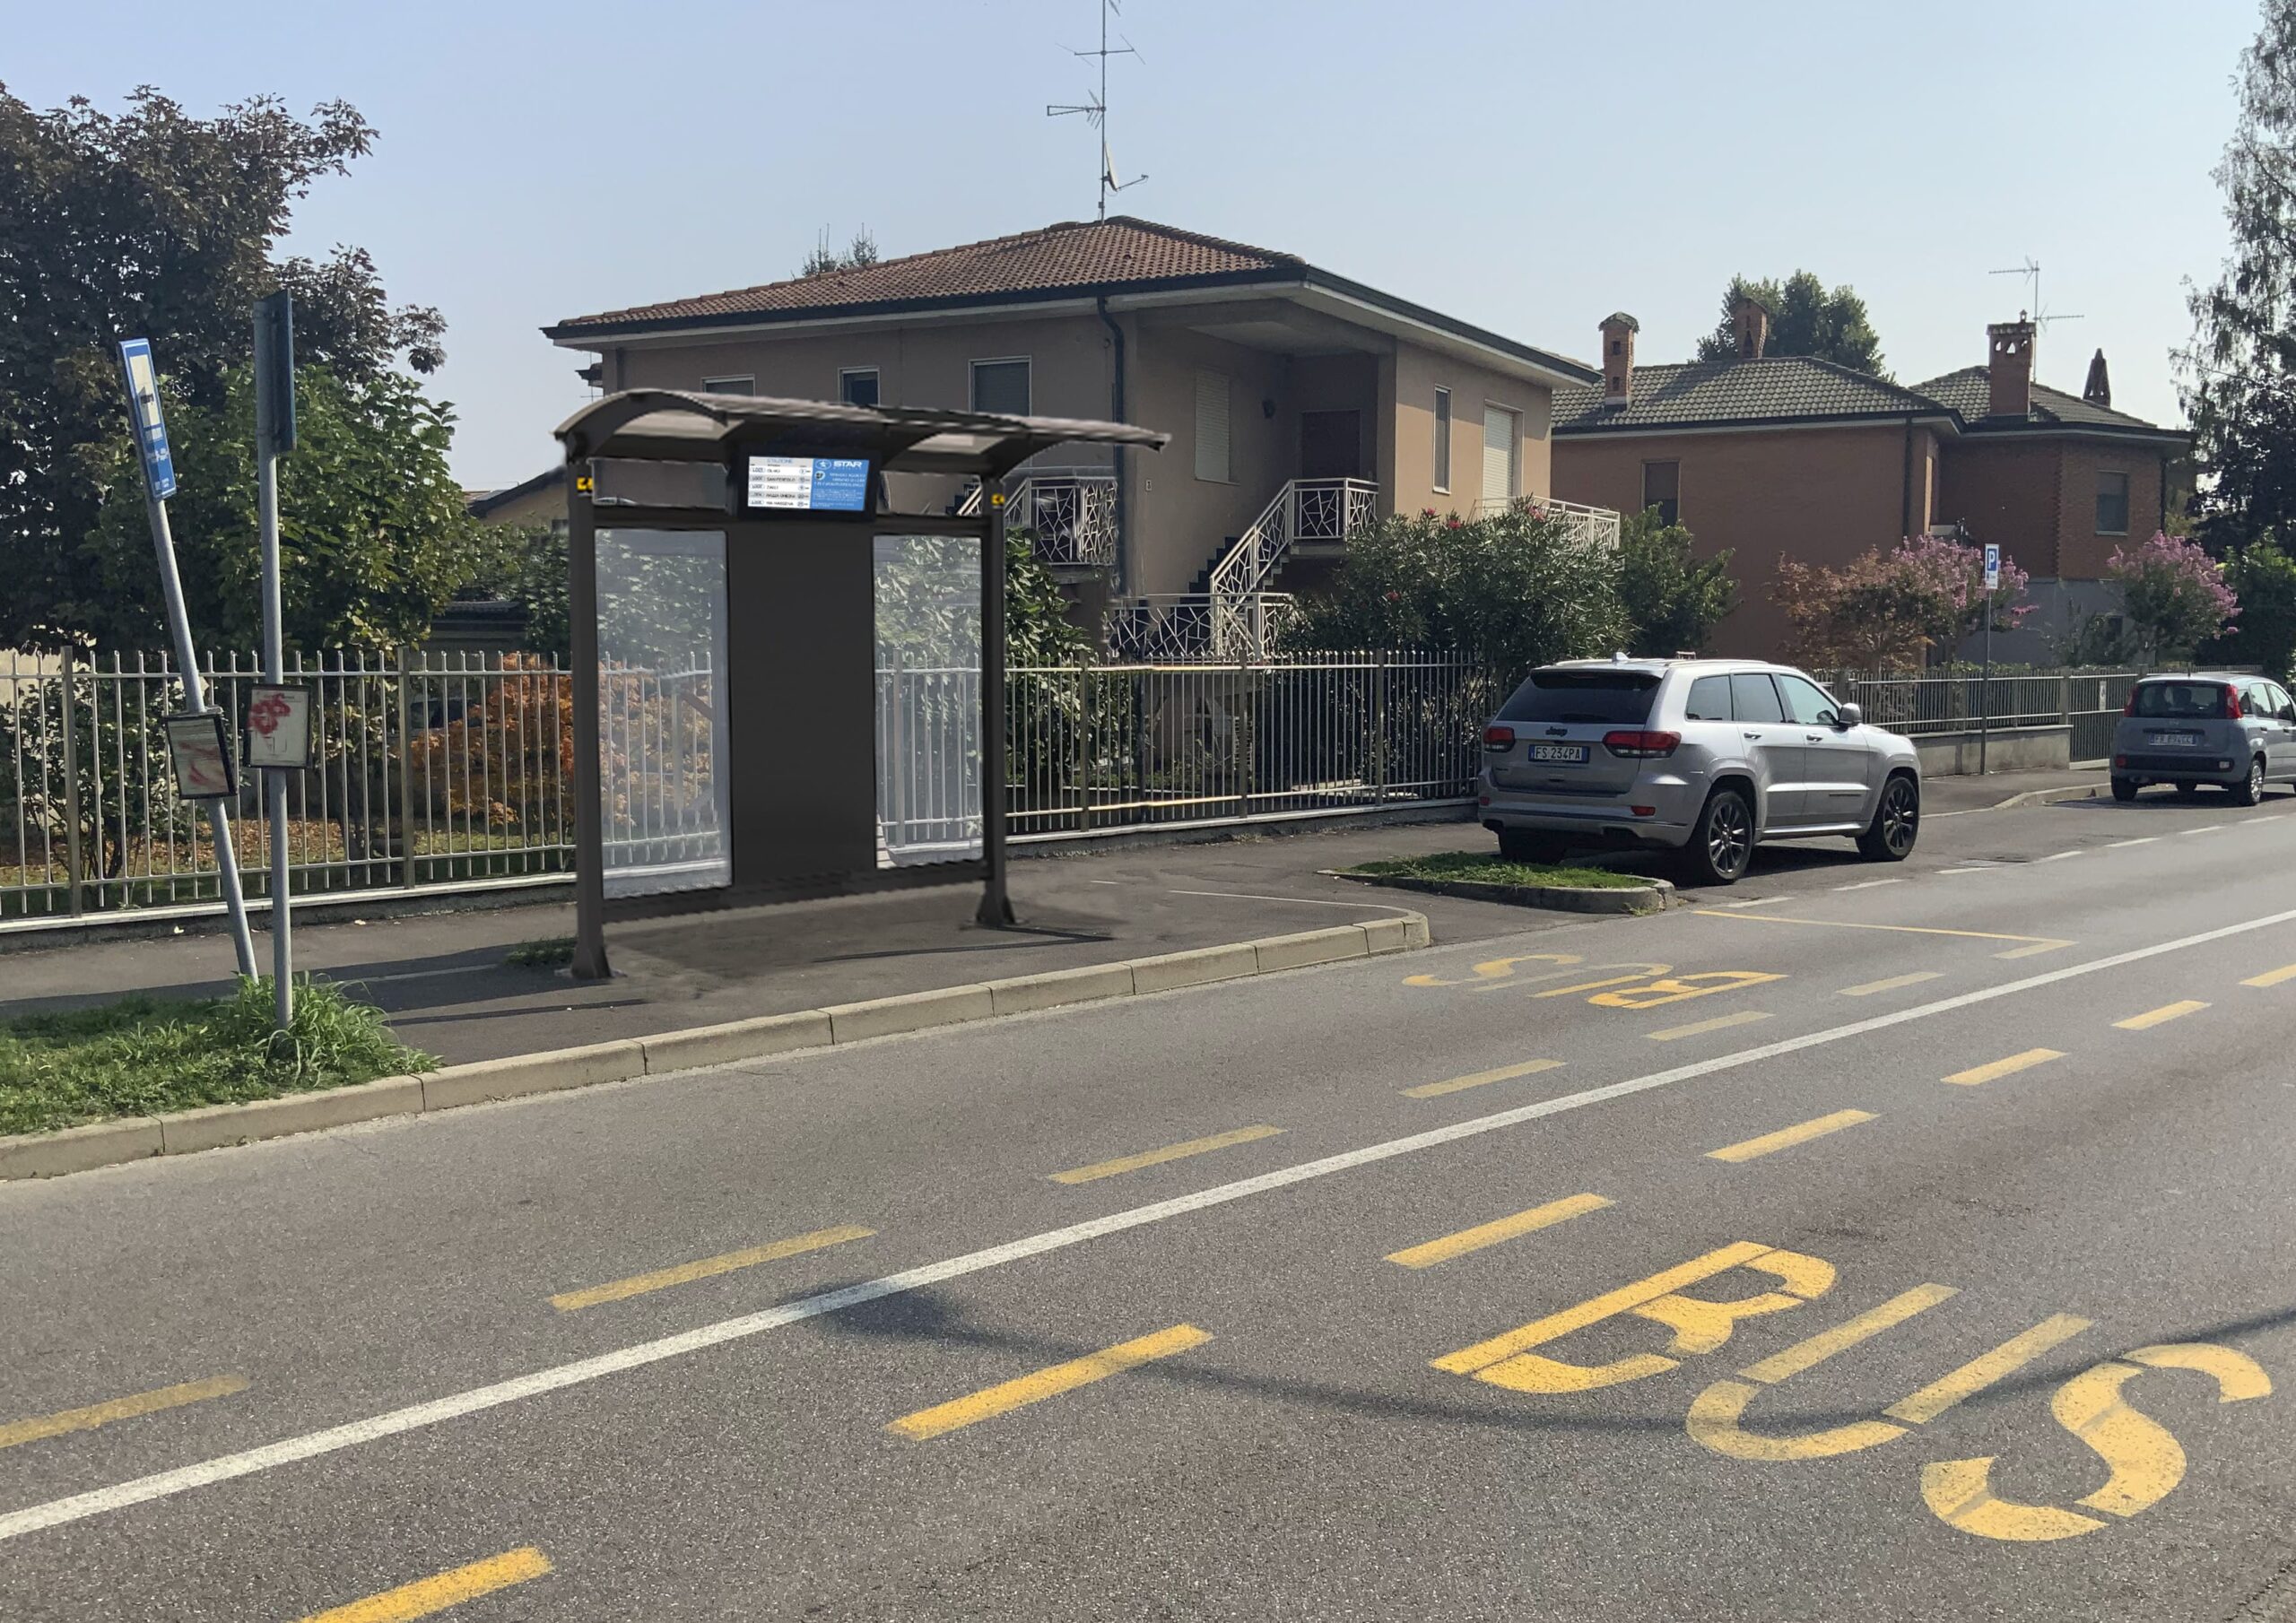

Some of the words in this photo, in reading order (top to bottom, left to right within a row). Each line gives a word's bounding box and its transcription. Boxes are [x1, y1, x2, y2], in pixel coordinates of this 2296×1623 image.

[1988, 551, 1996, 569] P
[1545, 725, 1568, 737] Jeep
[1535, 747, 1548, 759] FS
[1551, 747, 1580, 759] 234PA
[1402, 953, 1789, 1010] BUS
[1430, 1240, 2273, 1542] BUS
